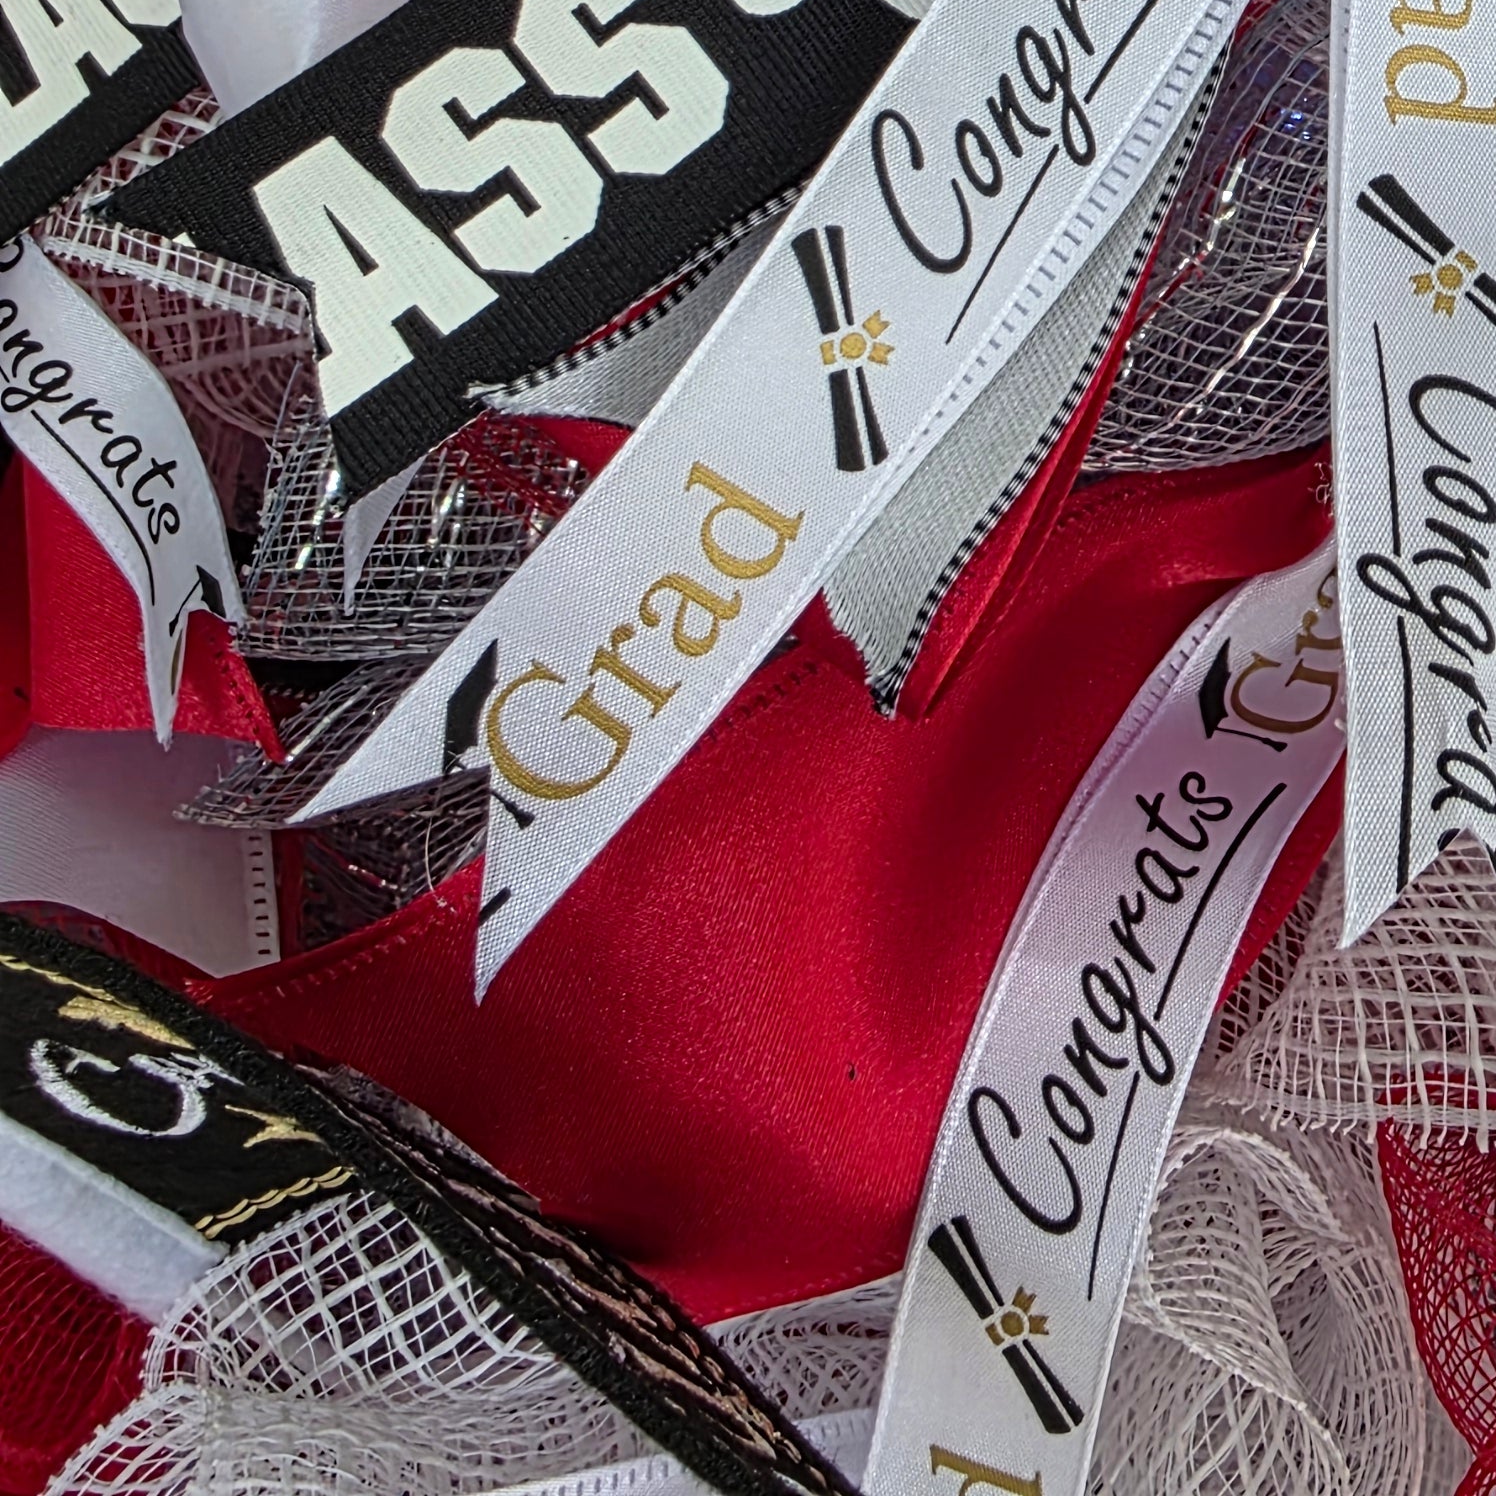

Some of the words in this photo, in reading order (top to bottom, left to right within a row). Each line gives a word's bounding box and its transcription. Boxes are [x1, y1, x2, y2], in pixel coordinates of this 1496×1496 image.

[485, 460, 806, 802] Grad
[968, 770, 1234, 1235] Congrats
[1230, 567, 1343, 734] Gr
